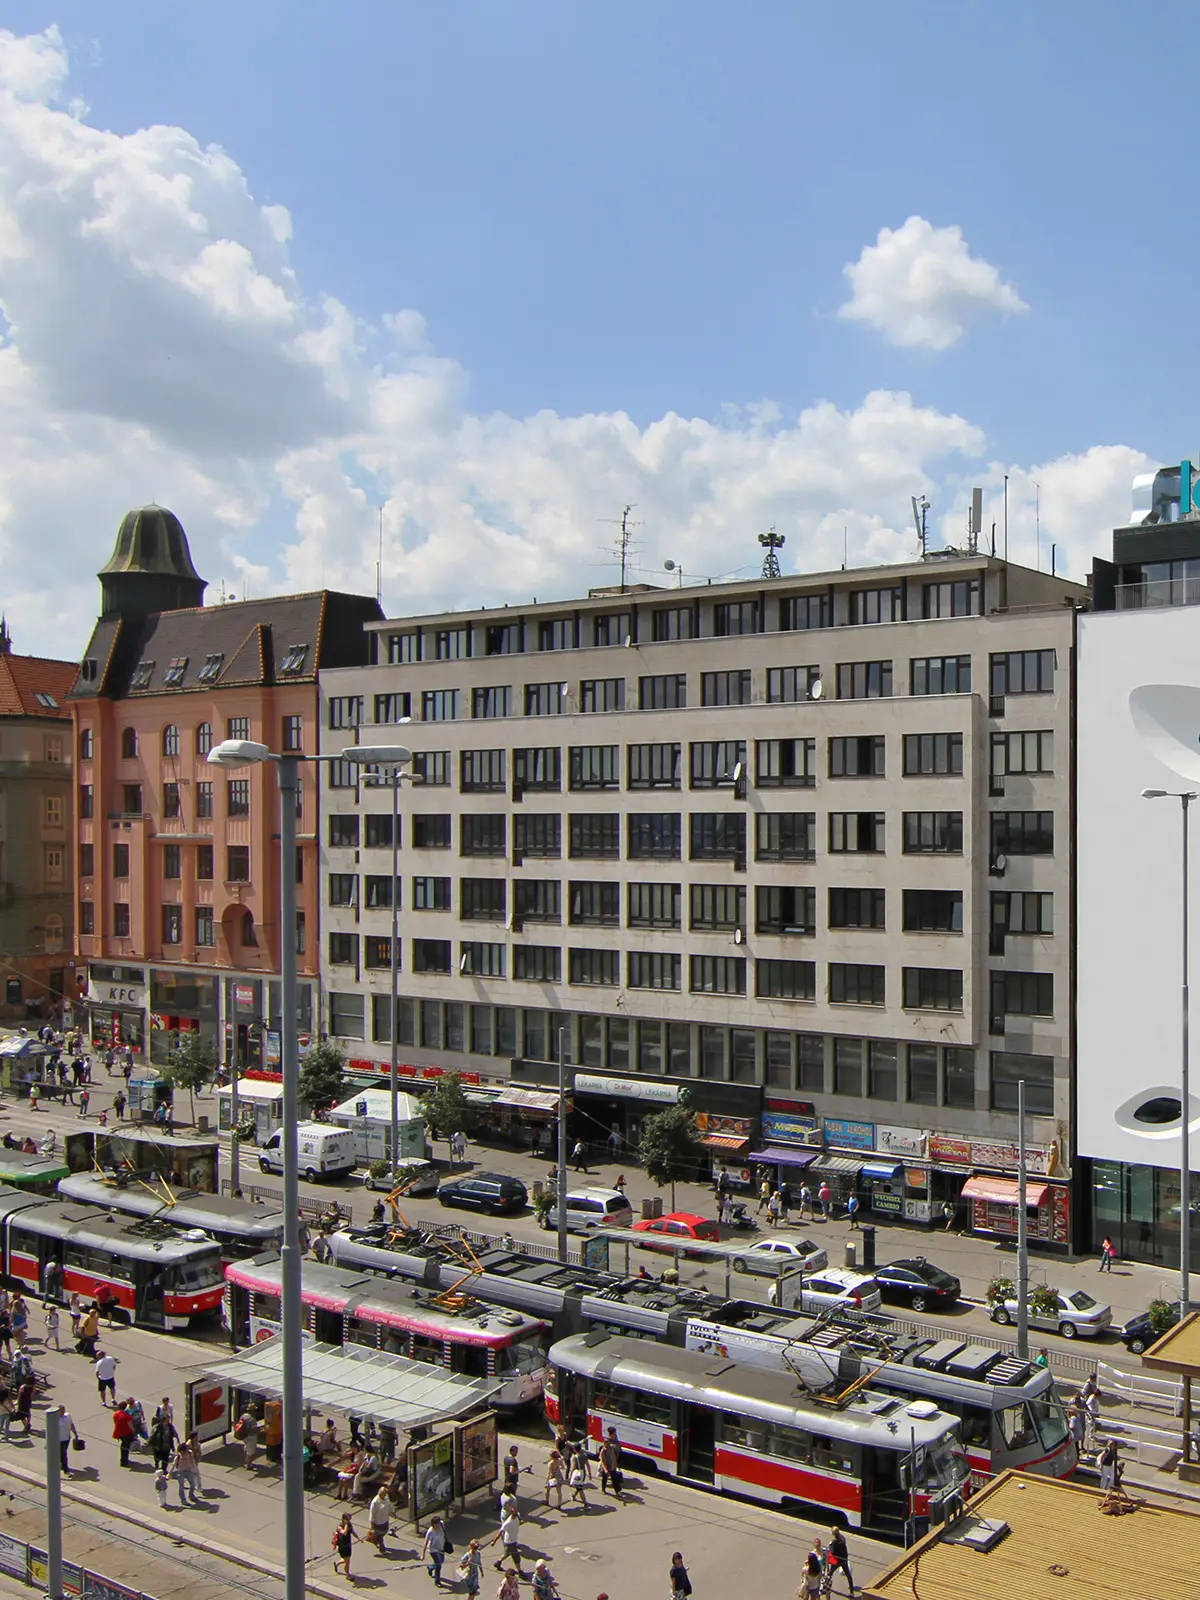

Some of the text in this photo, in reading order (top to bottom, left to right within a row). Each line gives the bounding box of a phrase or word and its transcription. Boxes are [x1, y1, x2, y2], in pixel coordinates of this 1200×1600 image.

[109, 987, 136, 1001] KFC
[358, 1103, 365, 1112] P
[930, 1146, 968, 1157] NONSTOP
[876, 1201, 900, 1210] CAMBIO
